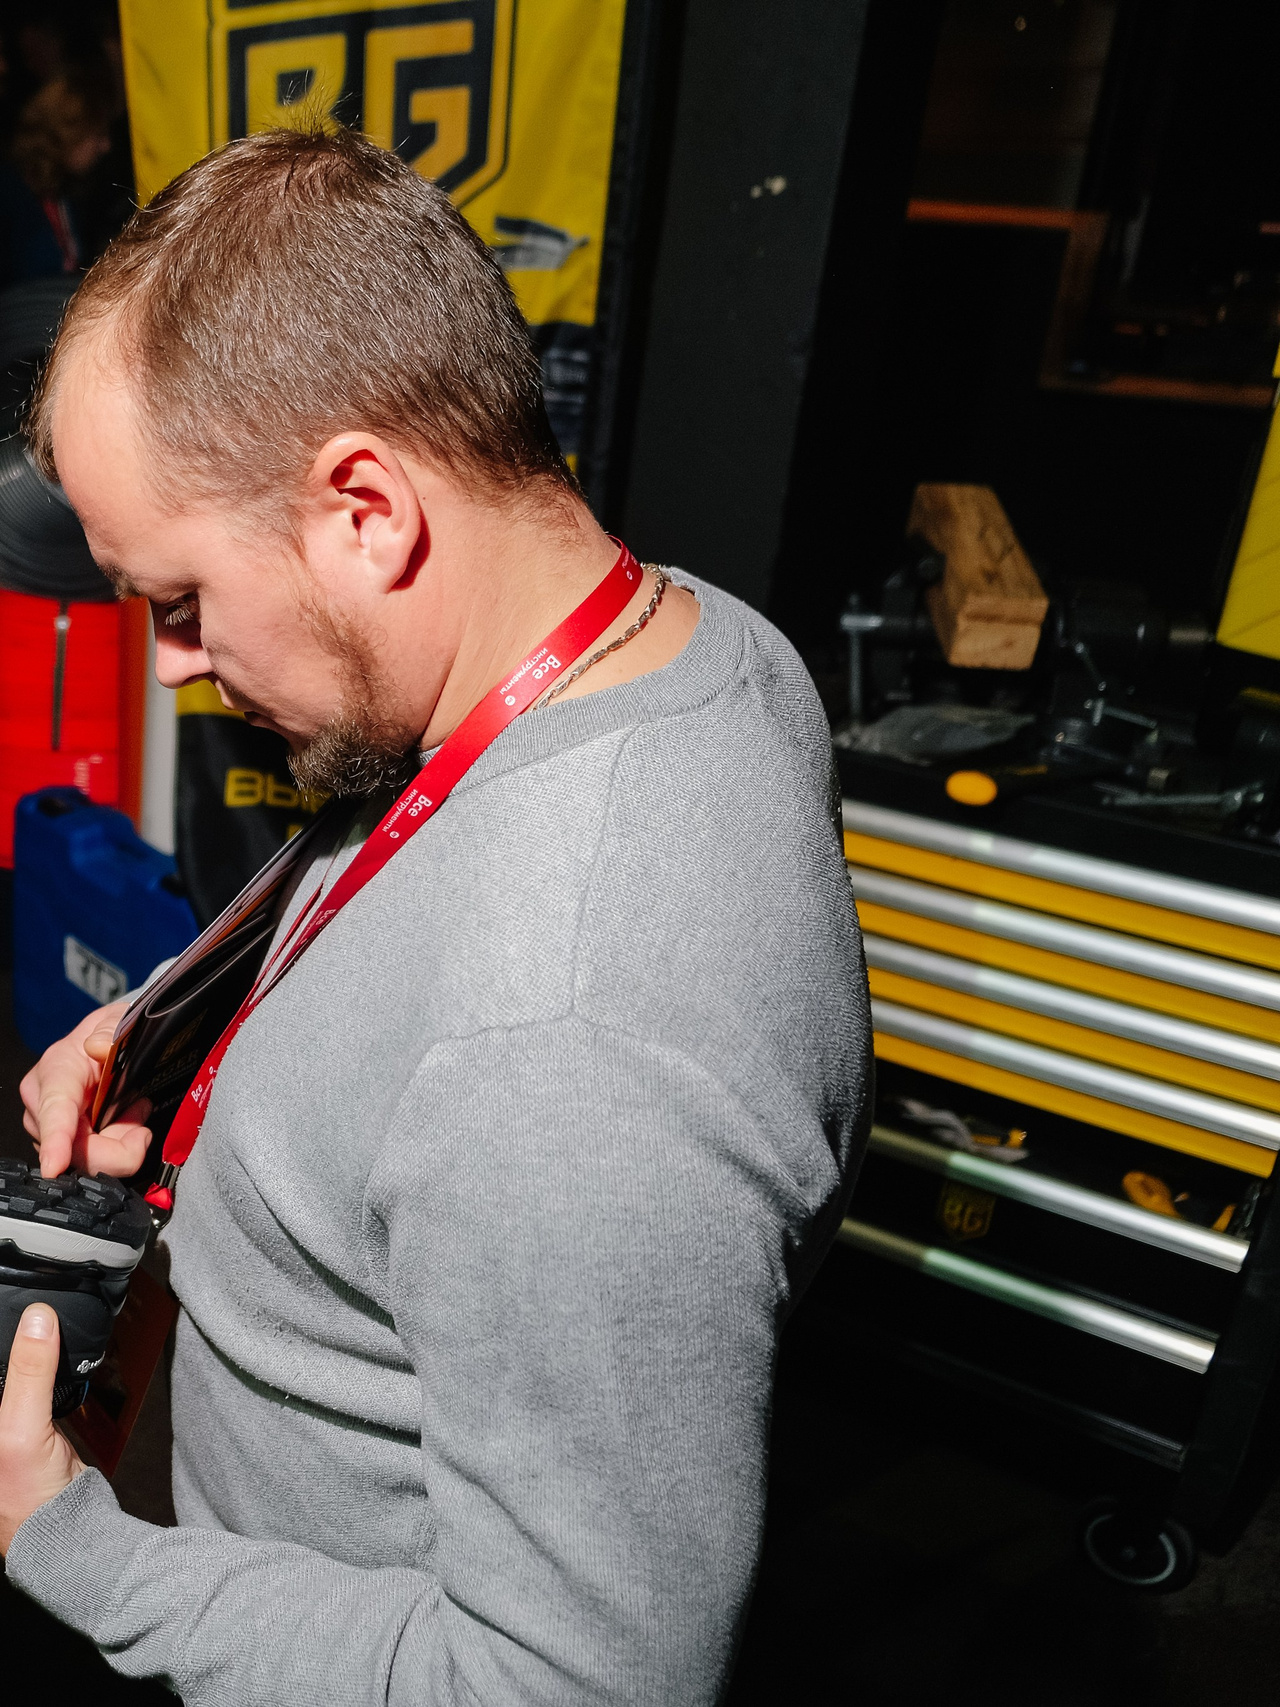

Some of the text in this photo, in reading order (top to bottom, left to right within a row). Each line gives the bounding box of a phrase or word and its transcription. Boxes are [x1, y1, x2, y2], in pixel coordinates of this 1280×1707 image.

[499, 647, 548, 695] инструменты
[532, 654, 562, 680] Все
[381, 789, 418, 832] инструменты
[408, 794, 433, 817] Все
[191, 1083, 203, 1103] Все
